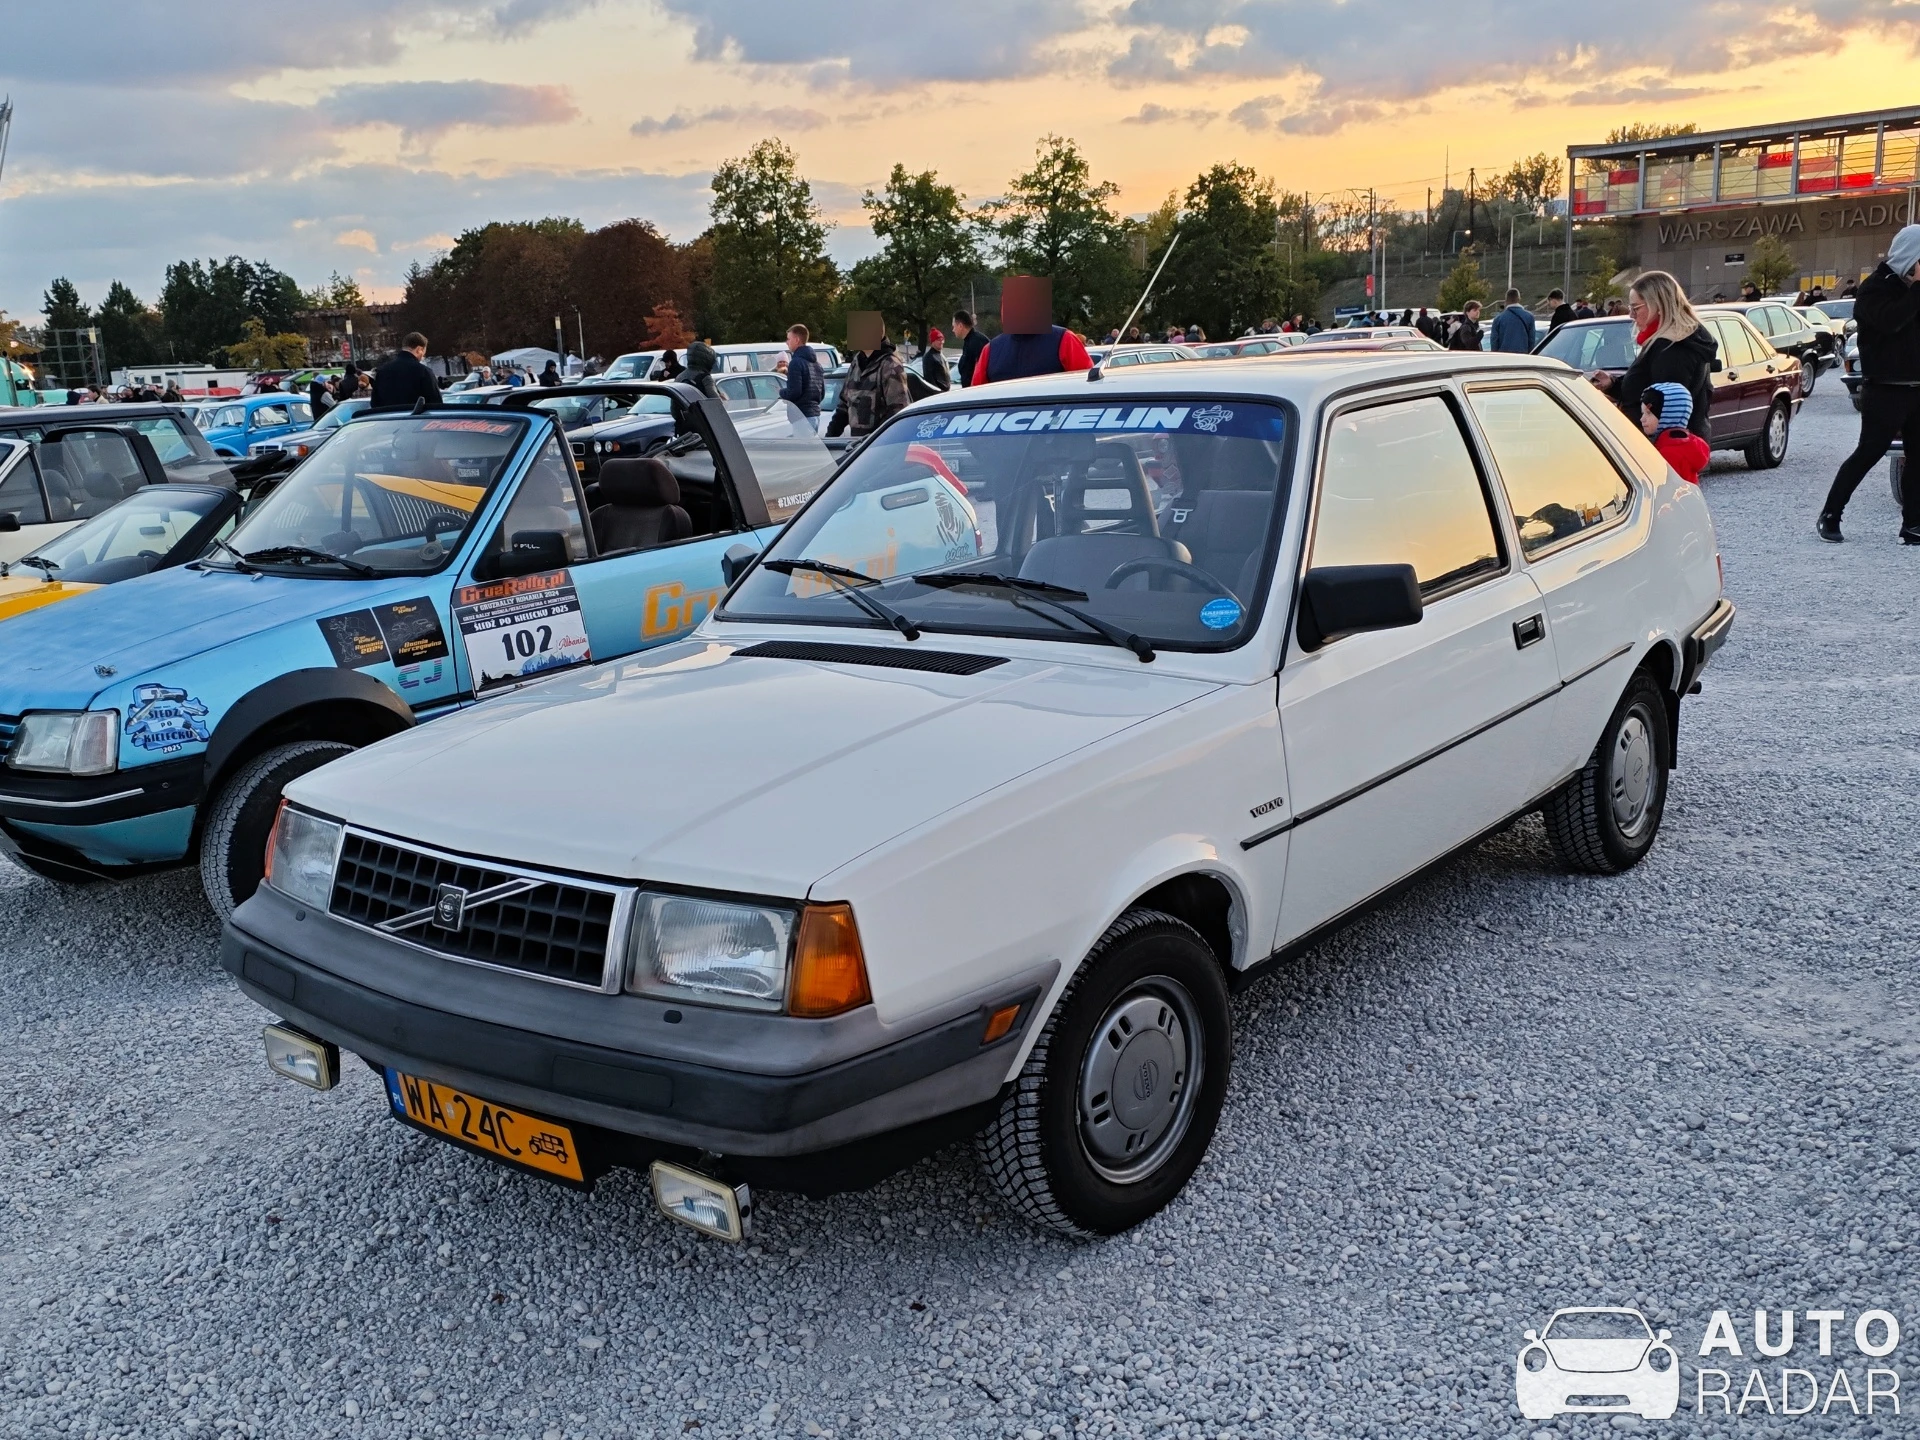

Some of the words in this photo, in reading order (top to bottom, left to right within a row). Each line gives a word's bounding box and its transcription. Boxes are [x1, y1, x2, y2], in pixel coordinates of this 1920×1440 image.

[1658, 212, 1804, 244] WARSZAWA
[1817, 203, 1920, 231] STADIO
[943, 407, 1190, 435] MICHELIN
[460, 570, 566, 605] GruzRally.pl
[480, 597, 515, 612] GRUZRALLY
[516, 592, 544, 604] ROMANIA
[499, 616, 511, 626] PO
[514, 608, 548, 623] KIELECKU
[551, 605, 569, 615] 2025
[502, 625, 553, 662] 102
[558, 635, 587, 651] Albania
[160, 720, 172, 728] PO
[143, 730, 193, 743] KIELECKU
[162, 744, 181, 753] 2025
[1250, 797, 1284, 818] VOLVO
[1141, 1061, 1151, 1098] VOLVO
[392, 1091, 404, 1107] PL
[402, 1073, 448, 1129] WA
[453, 1094, 522, 1156] 24C
